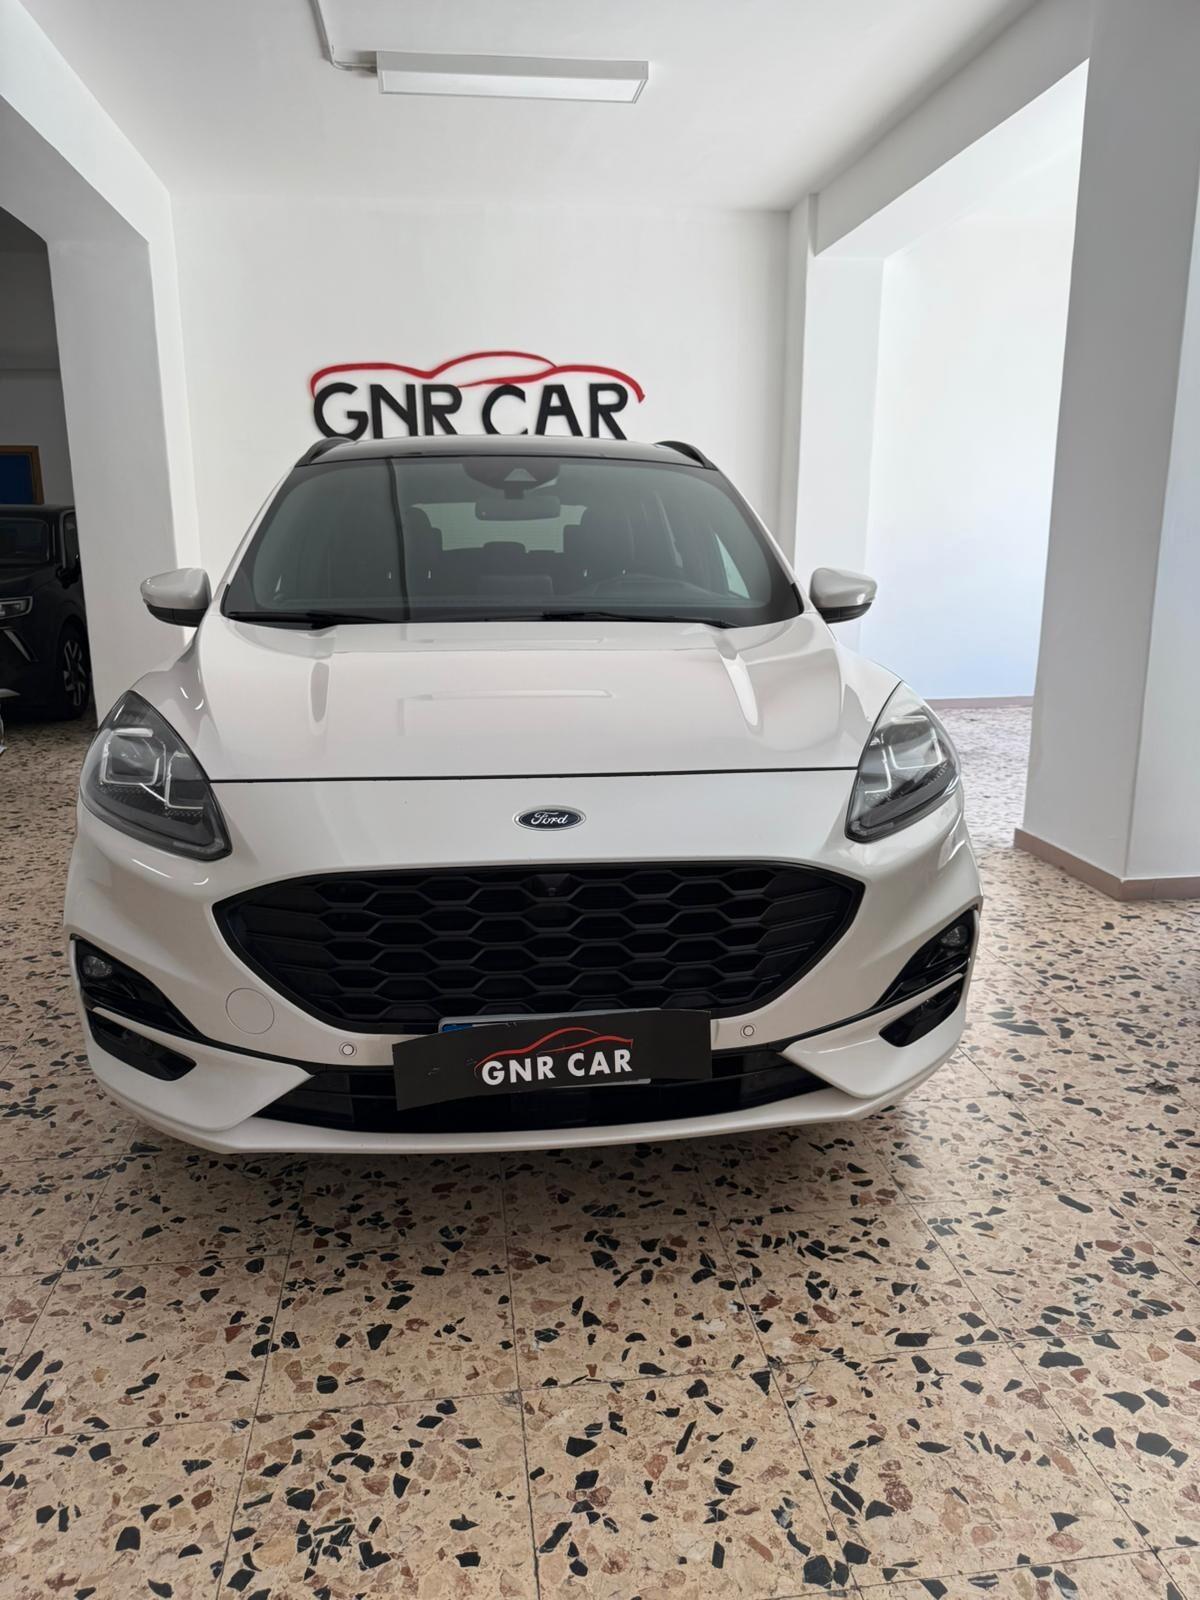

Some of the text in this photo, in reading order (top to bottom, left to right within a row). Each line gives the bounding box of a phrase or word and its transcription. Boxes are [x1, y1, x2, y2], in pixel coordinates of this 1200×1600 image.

[313, 382, 628, 440] GNR CAR
[530, 811, 569, 825] Ford
[481, 1048, 633, 1086] GNR CAR
